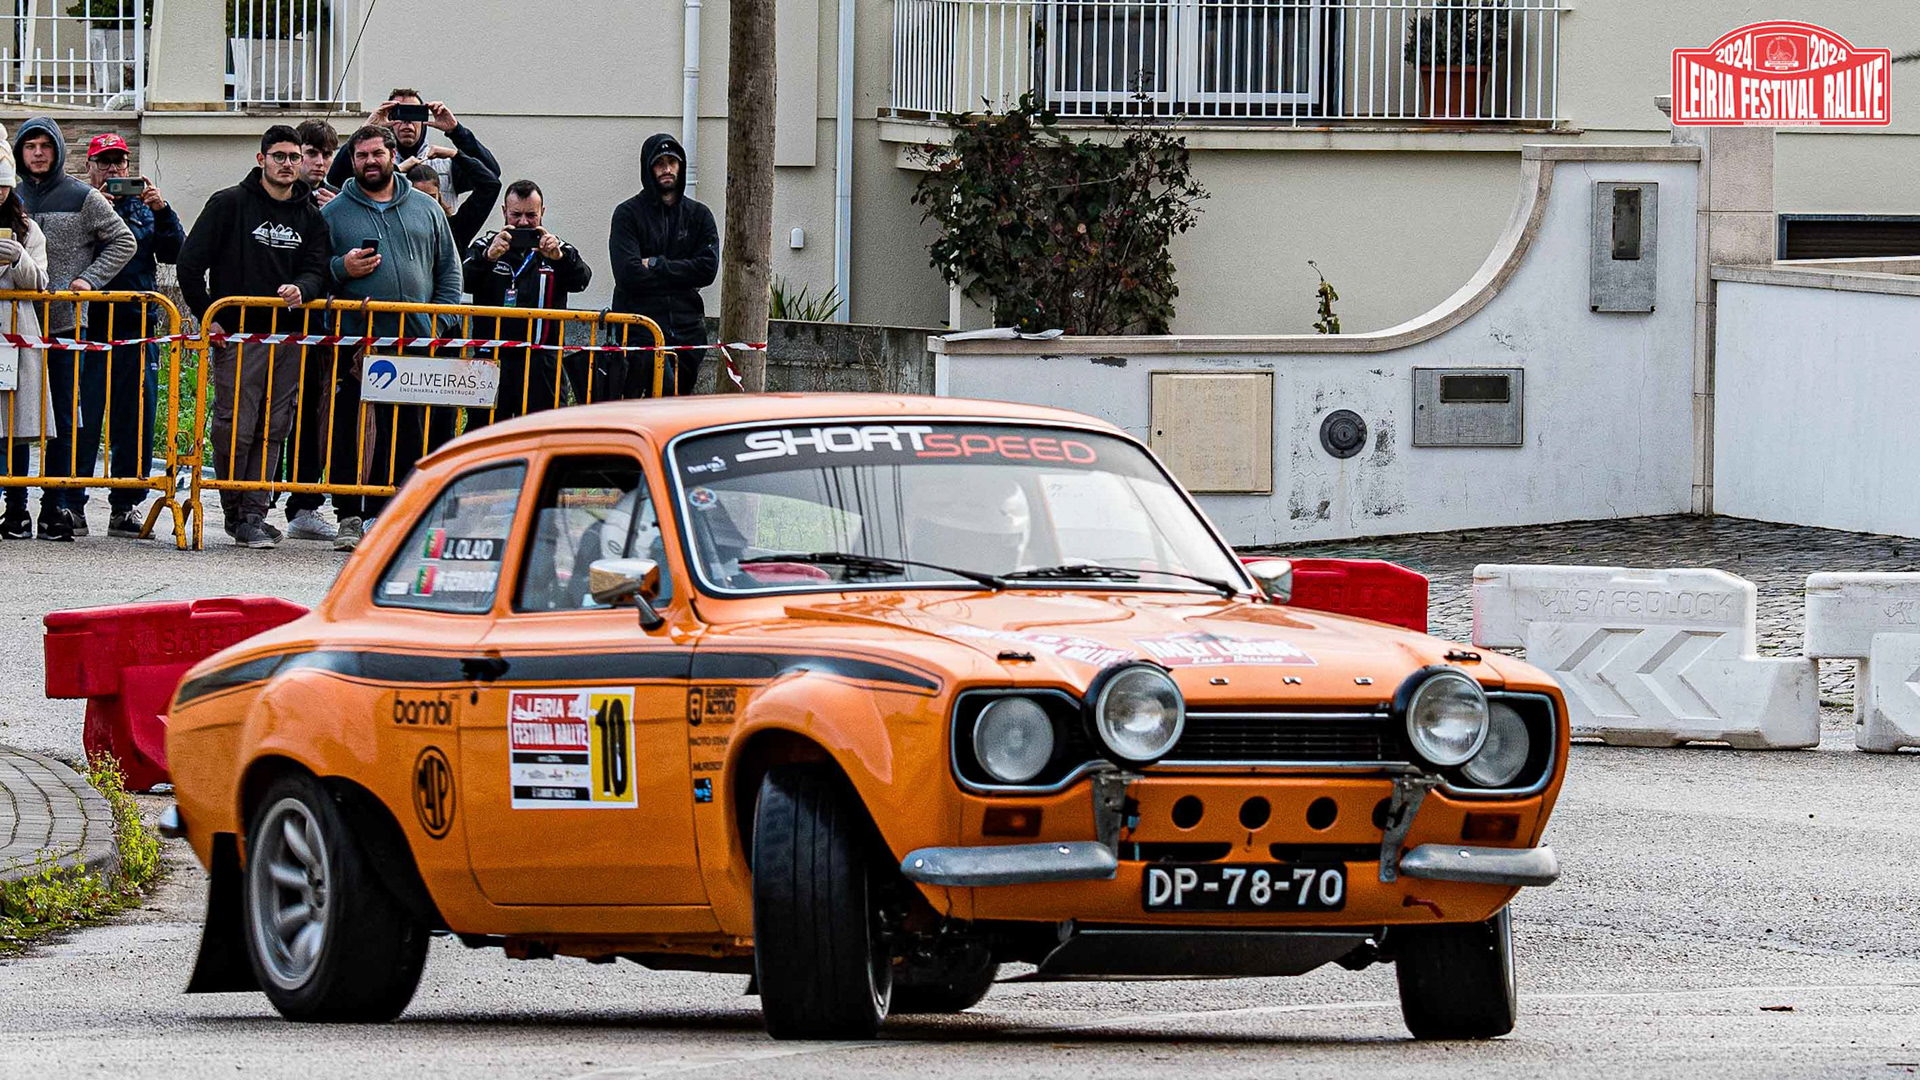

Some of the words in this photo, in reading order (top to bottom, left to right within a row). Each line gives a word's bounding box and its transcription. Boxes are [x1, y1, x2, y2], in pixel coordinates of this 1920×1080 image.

[393, 691, 452, 725] bambi
[595, 698, 627, 797] 10
[1149, 867, 1343, 905] DP-78-70
